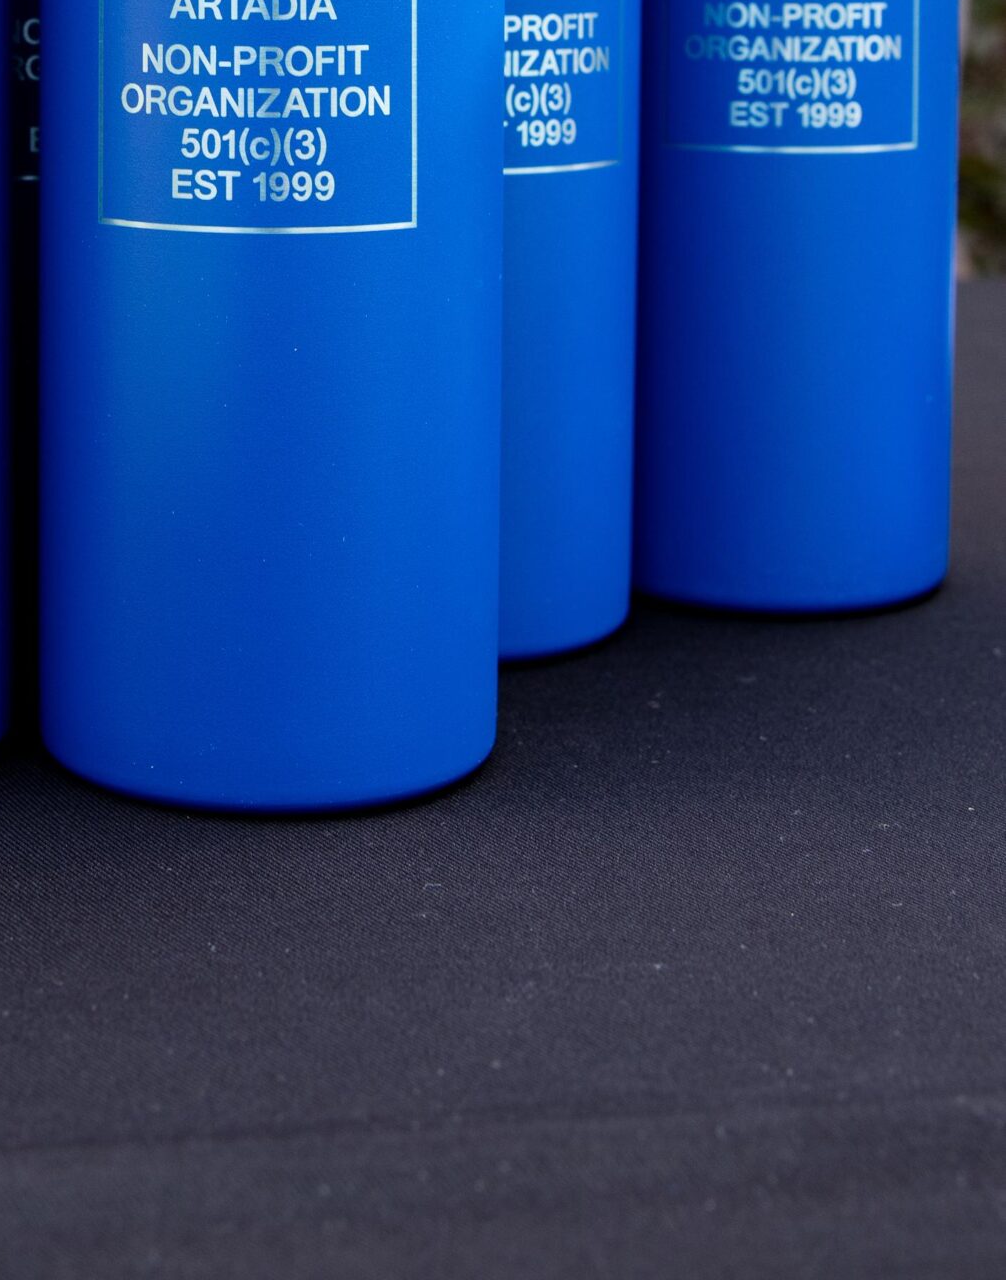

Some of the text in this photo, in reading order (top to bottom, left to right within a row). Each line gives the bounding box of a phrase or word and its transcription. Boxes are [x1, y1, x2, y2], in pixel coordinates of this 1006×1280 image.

[703, 1, 888, 30] NON-PROFIT
[142, 43, 370, 77] NON-PROFIT
[685, 34, 901, 62] ORGANIZATION
[738, 67, 857, 100] 501(c)(3)
[121, 83, 390, 119] ORGANIZATION
[729, 101, 862, 128] EST 1999
[180, 127, 327, 167] 501(c)(3)
[516, 118, 577, 147] 1999
[171, 168, 335, 202] EST 1999
